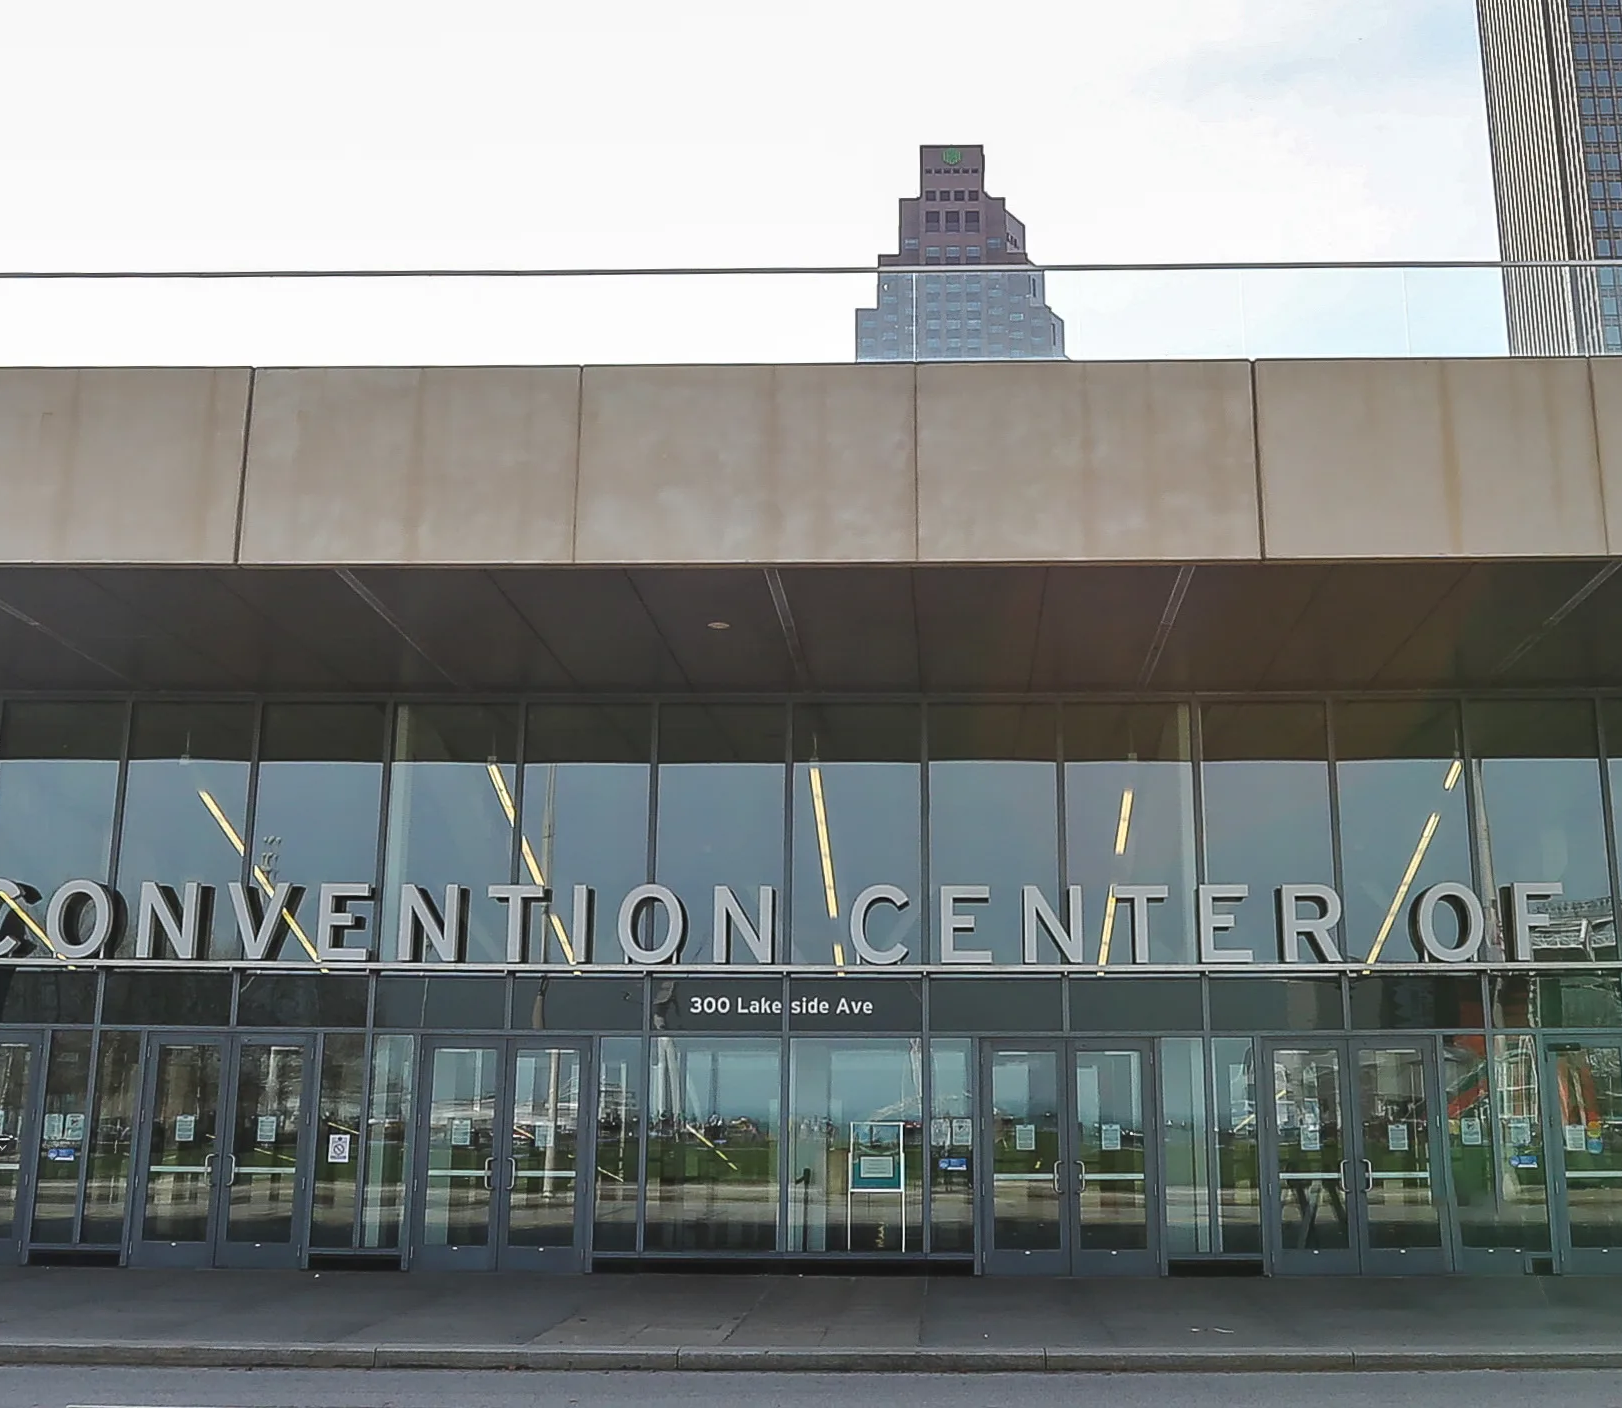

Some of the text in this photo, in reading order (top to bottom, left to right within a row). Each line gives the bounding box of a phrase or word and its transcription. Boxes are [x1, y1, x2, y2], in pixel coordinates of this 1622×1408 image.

[849, 881, 1344, 965] CENTER
[1418, 881, 1564, 963] OF
[689, 996, 731, 1014] 300
[836, 996, 874, 1014] Ave
